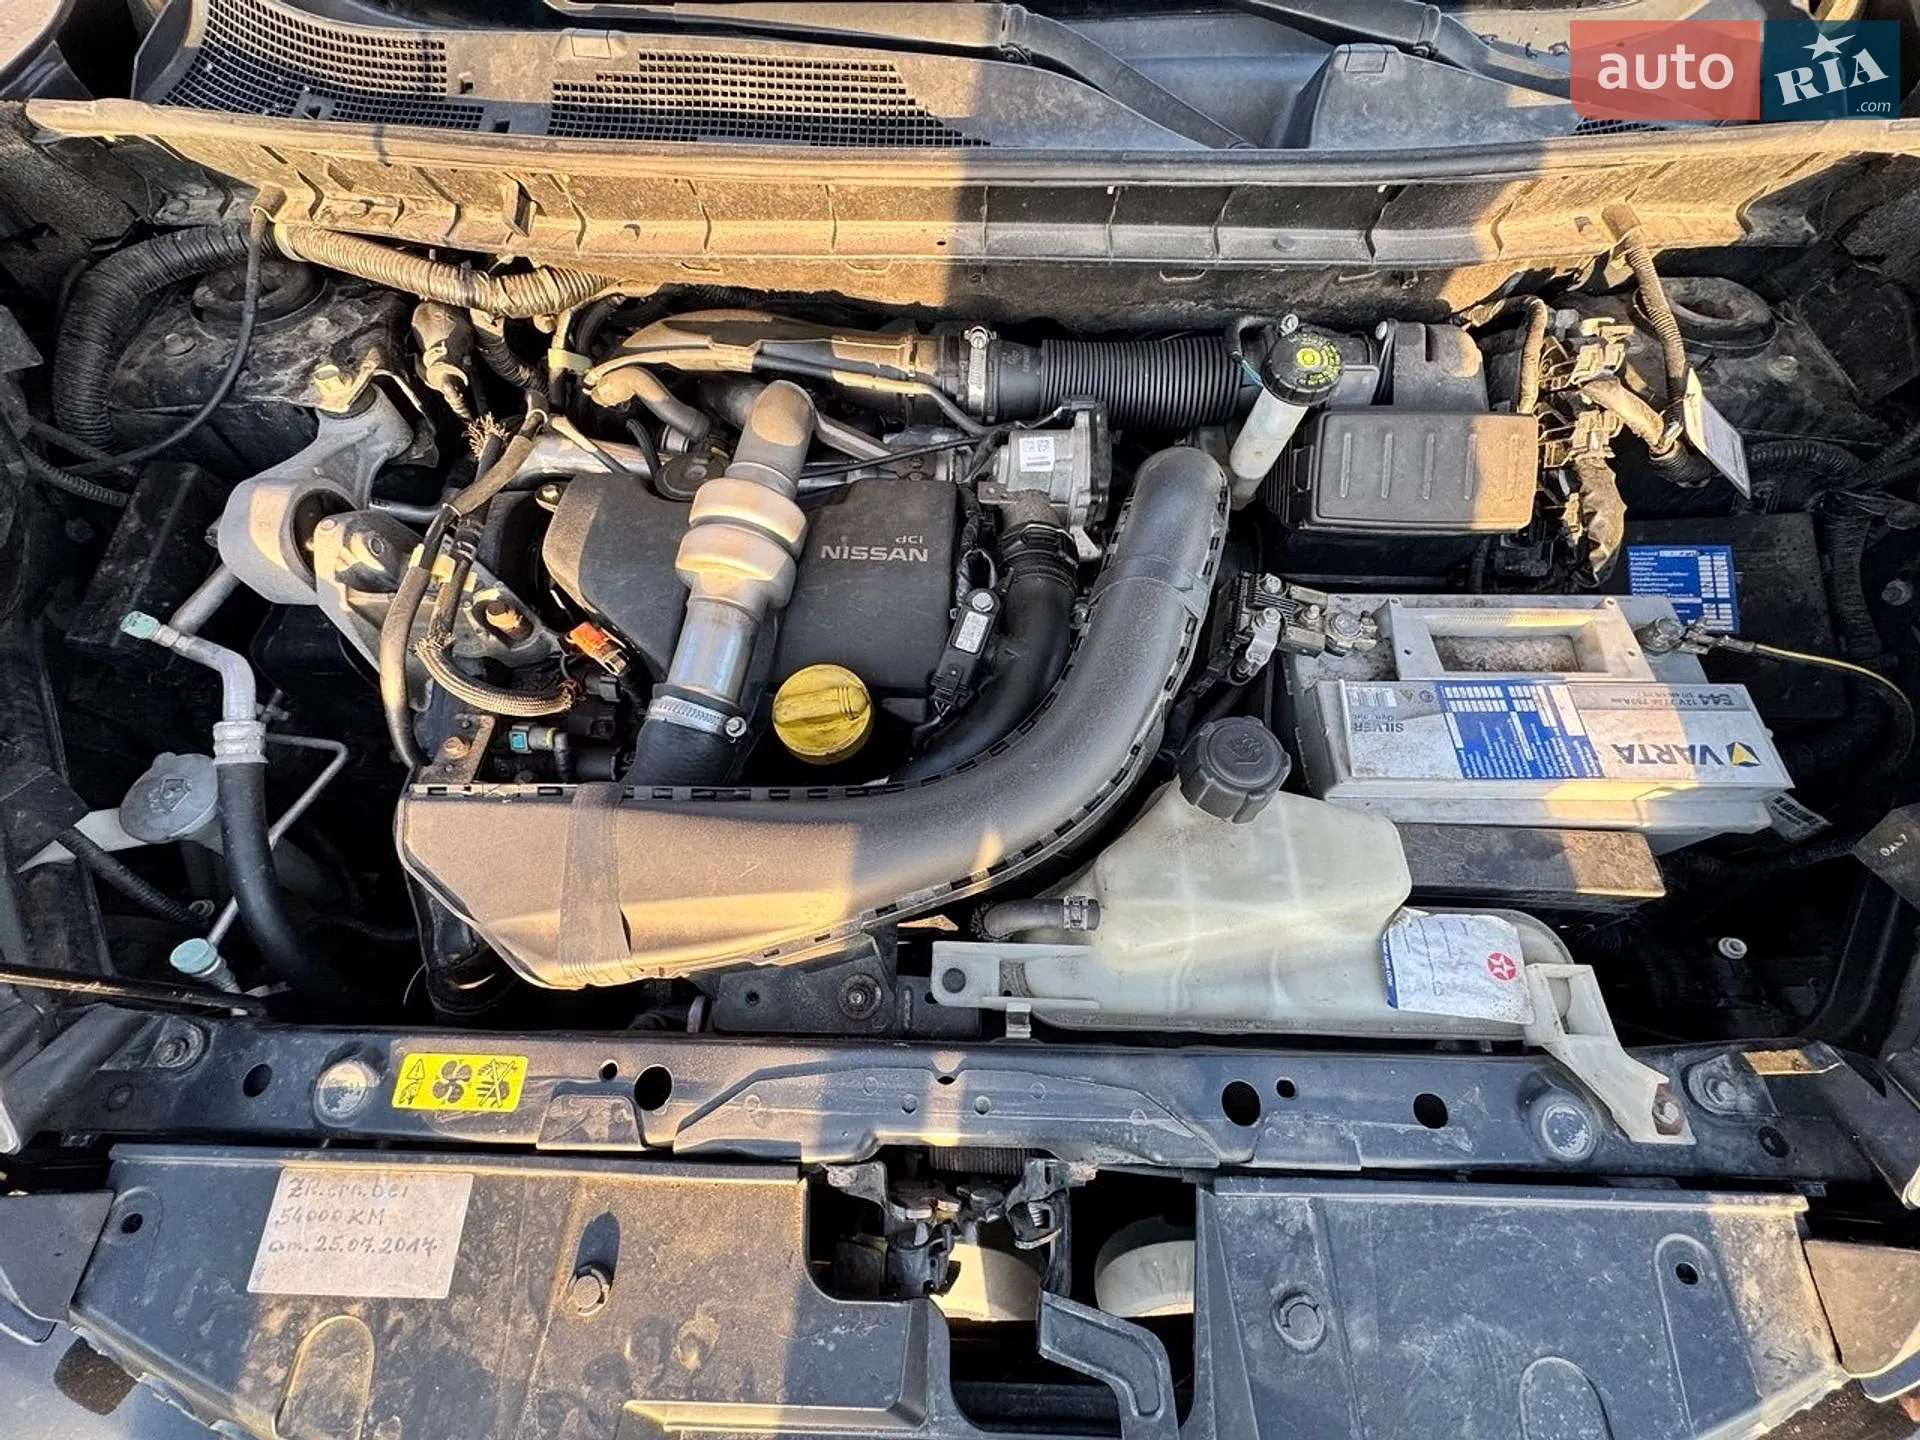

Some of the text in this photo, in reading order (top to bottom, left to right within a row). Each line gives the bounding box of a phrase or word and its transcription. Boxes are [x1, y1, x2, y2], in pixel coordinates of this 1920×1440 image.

[819, 545, 929, 562] NISSAN
[1354, 722, 1405, 733] SILVER
[1611, 743, 1725, 765] VARTA
[346, 1207, 385, 1225] KM
